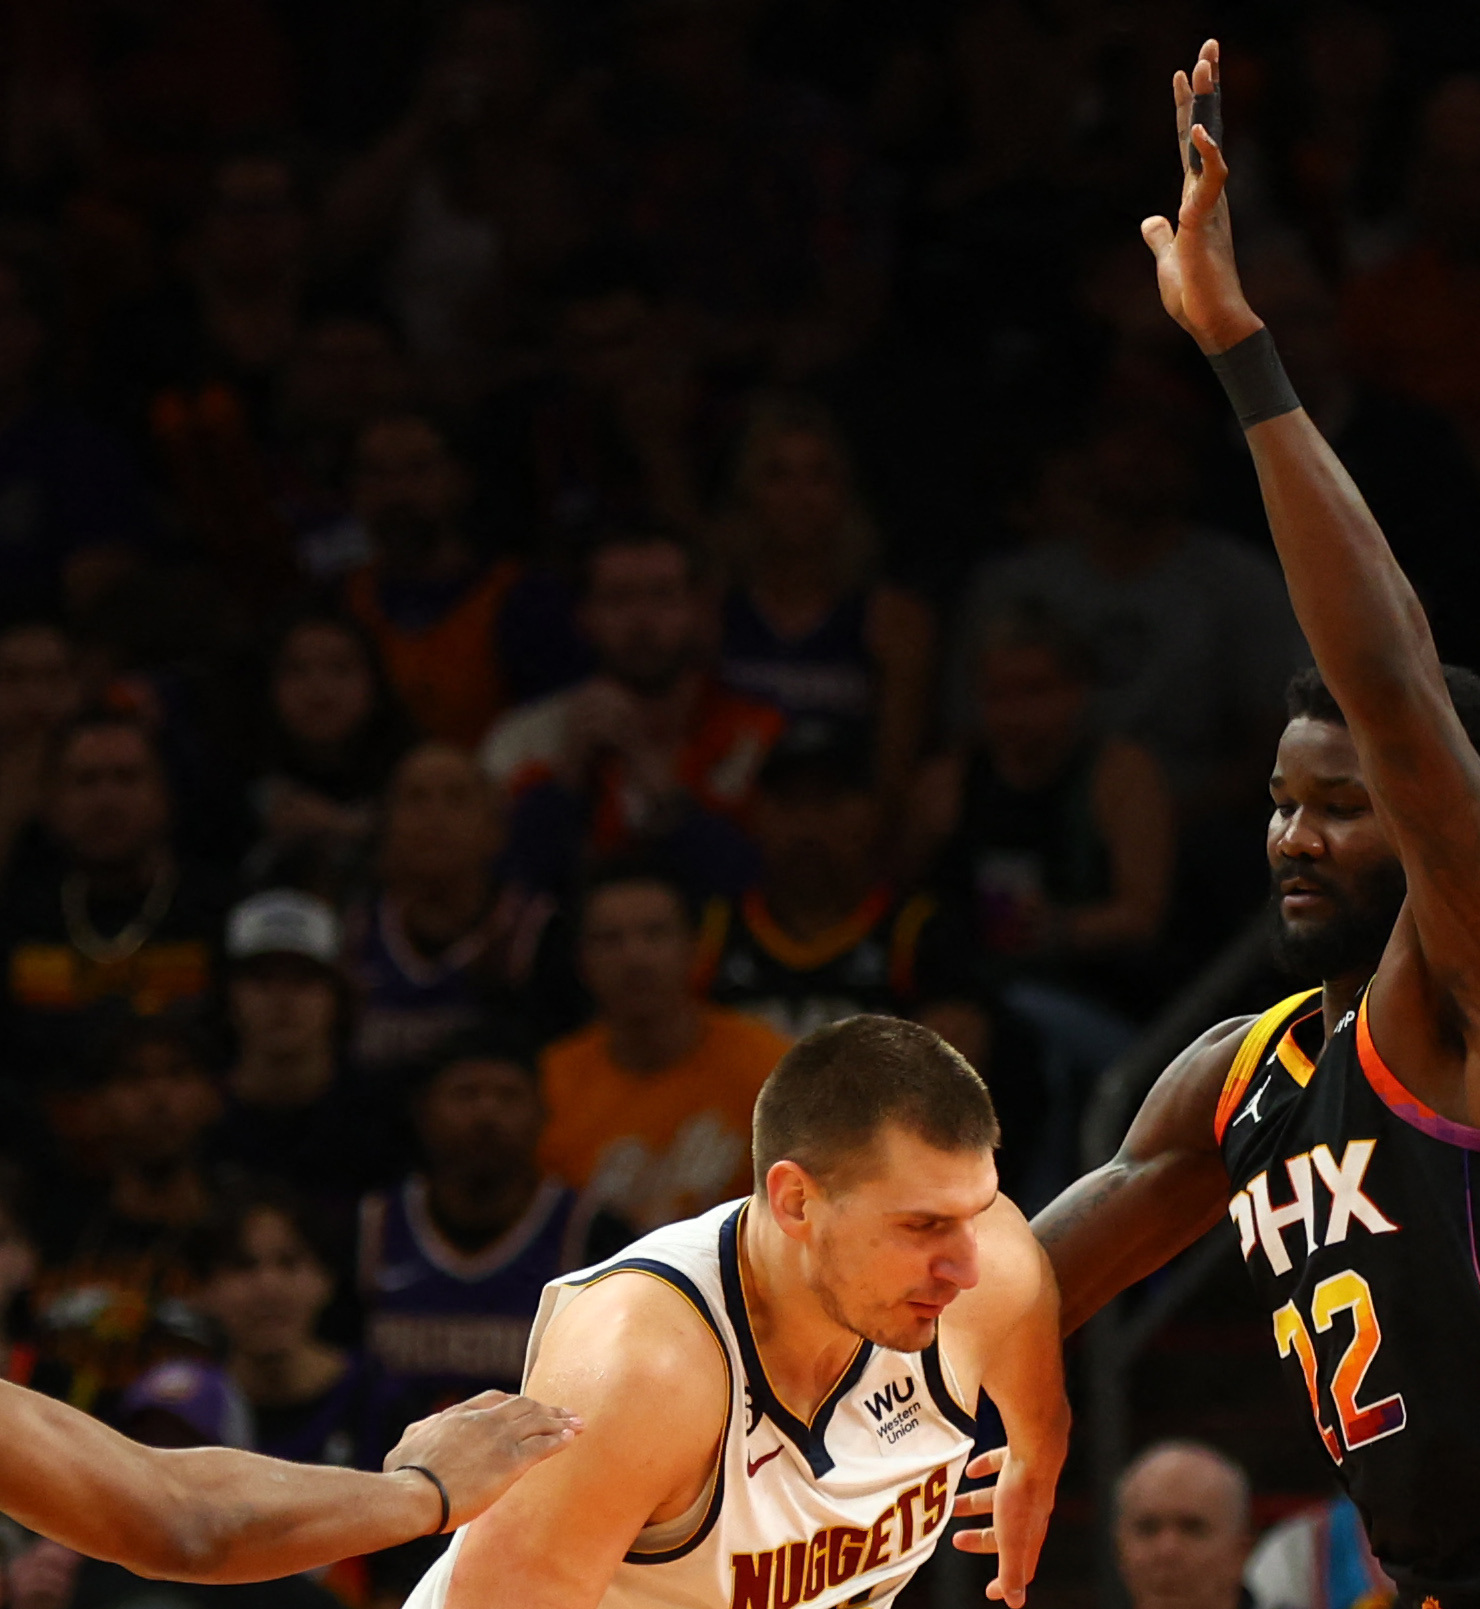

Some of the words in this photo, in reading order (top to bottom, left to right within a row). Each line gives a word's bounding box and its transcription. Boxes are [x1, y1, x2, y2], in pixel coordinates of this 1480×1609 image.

[864, 1376, 915, 1422] WU
[876, 1402, 922, 1439] Western
[886, 1417, 920, 1445] Union
